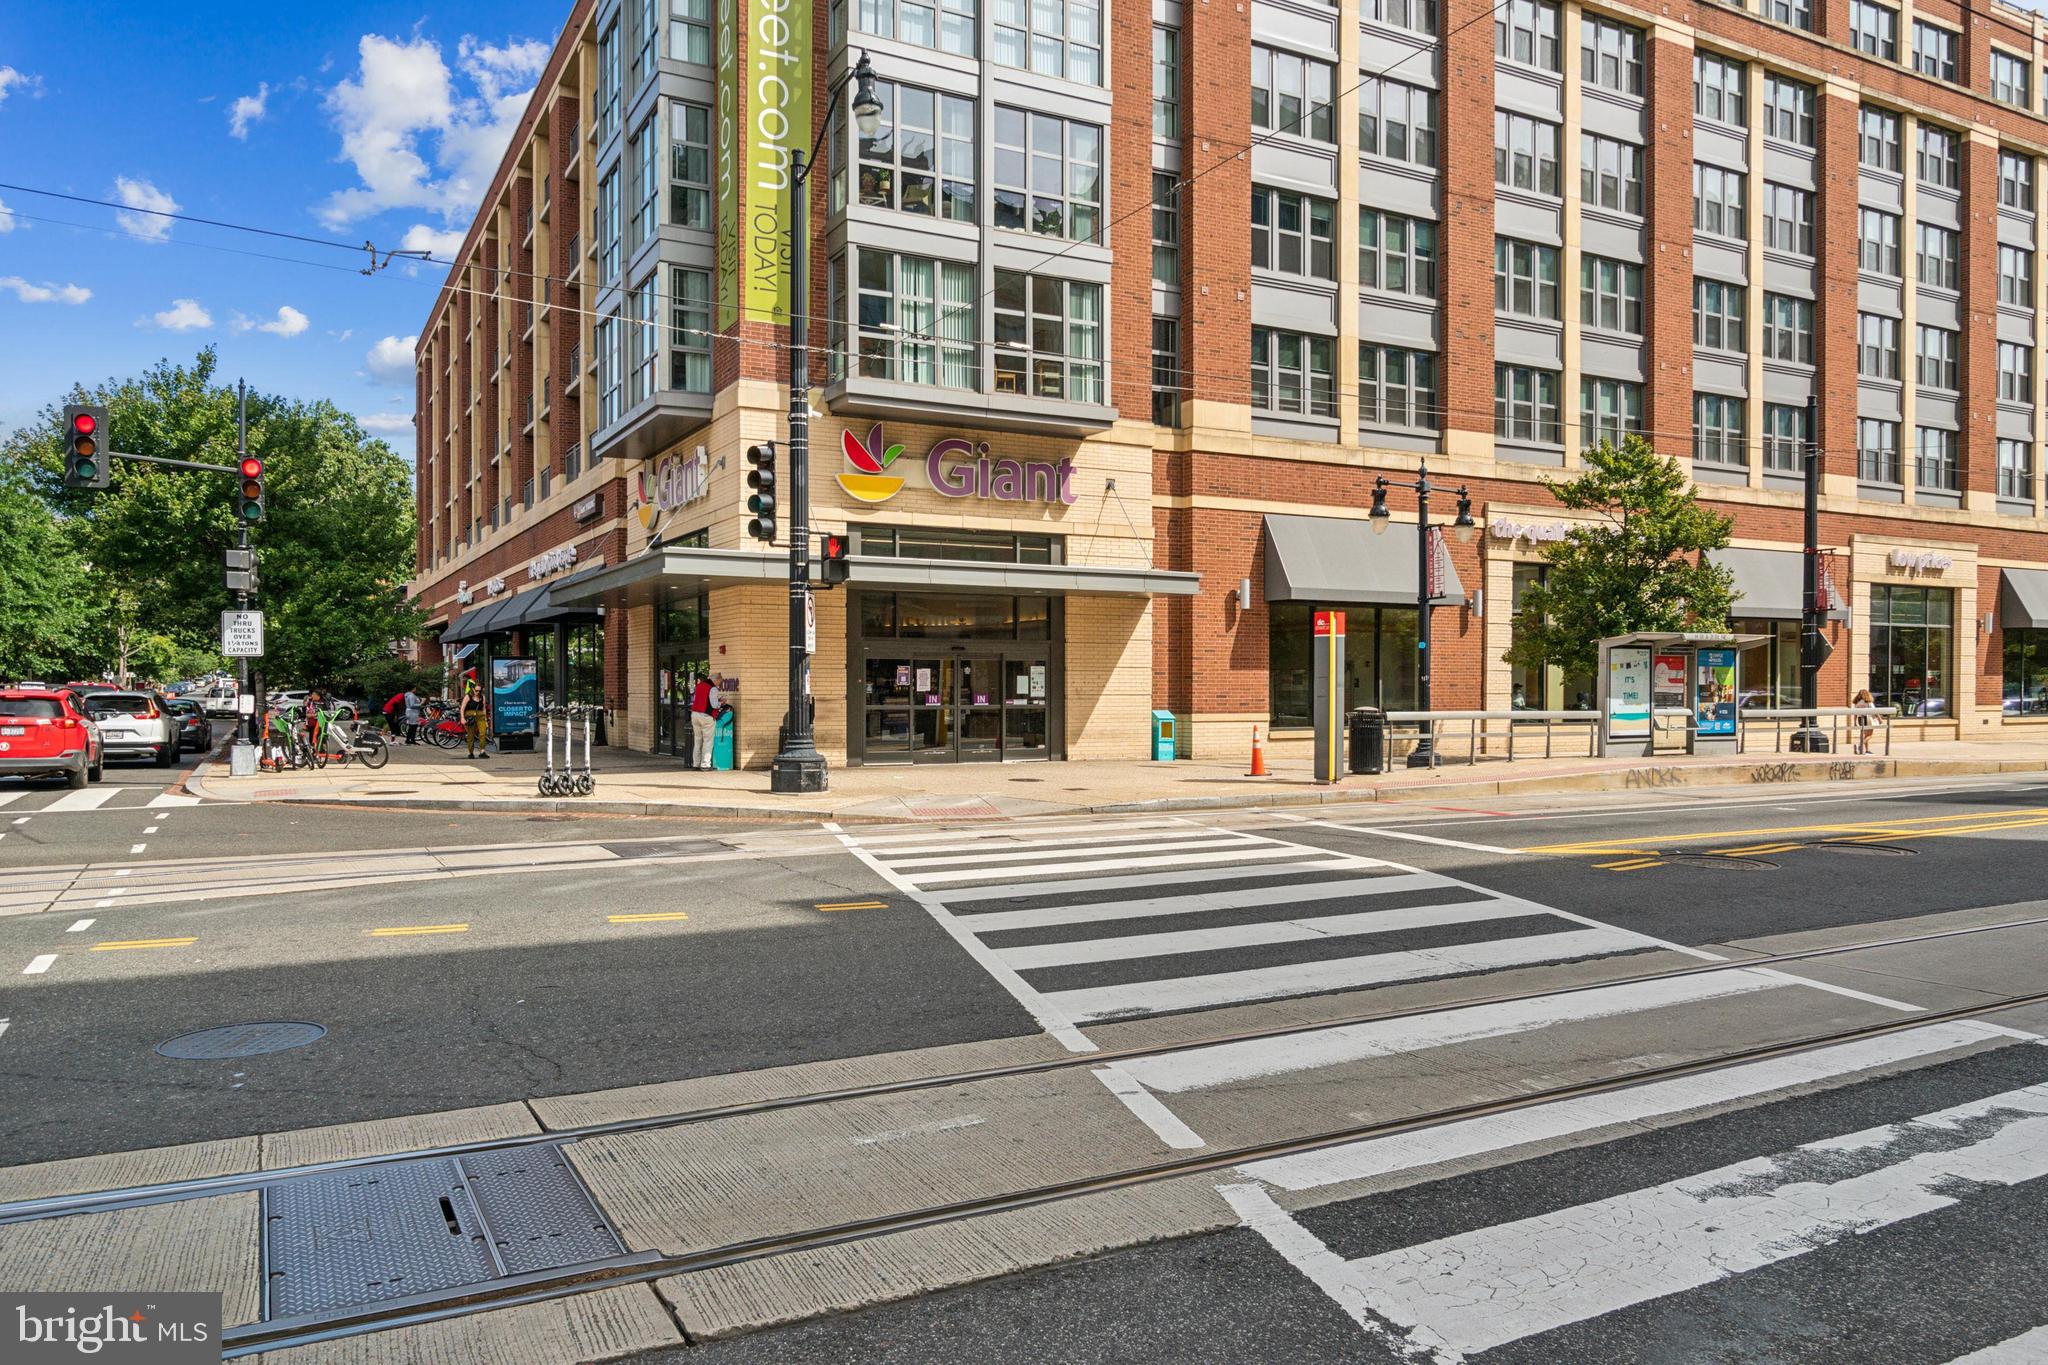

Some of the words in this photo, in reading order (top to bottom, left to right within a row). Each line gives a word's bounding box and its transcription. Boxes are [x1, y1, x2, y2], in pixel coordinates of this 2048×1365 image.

[754, 204, 778, 293] TODAY!
[657, 446, 708, 512] Giant
[927, 438, 1079, 505] Giant
[1494, 517, 1522, 539] the
[928, 694, 938, 704] IN
[976, 694, 986, 704] IN
